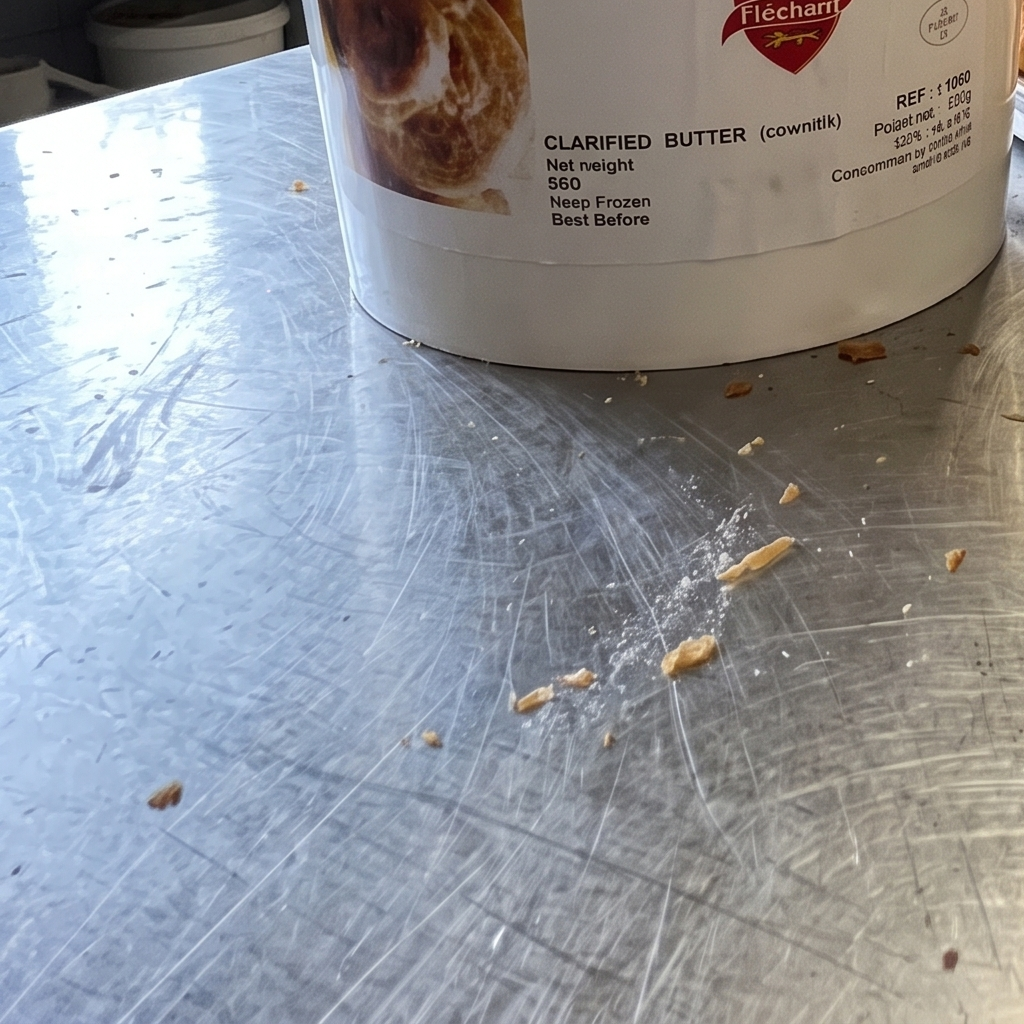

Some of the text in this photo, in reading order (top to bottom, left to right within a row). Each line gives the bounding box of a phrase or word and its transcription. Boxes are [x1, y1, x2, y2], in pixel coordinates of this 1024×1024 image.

[896, 87, 926, 110] REF
[945, 70, 971, 92] 1060
[543, 134, 652, 151] CLARIFIED
[664, 127, 747, 149] BUTTER
[546, 158, 575, 172] Net
[549, 195, 651, 212] Neep Frozen
[551, 211, 650, 227] Best Before
